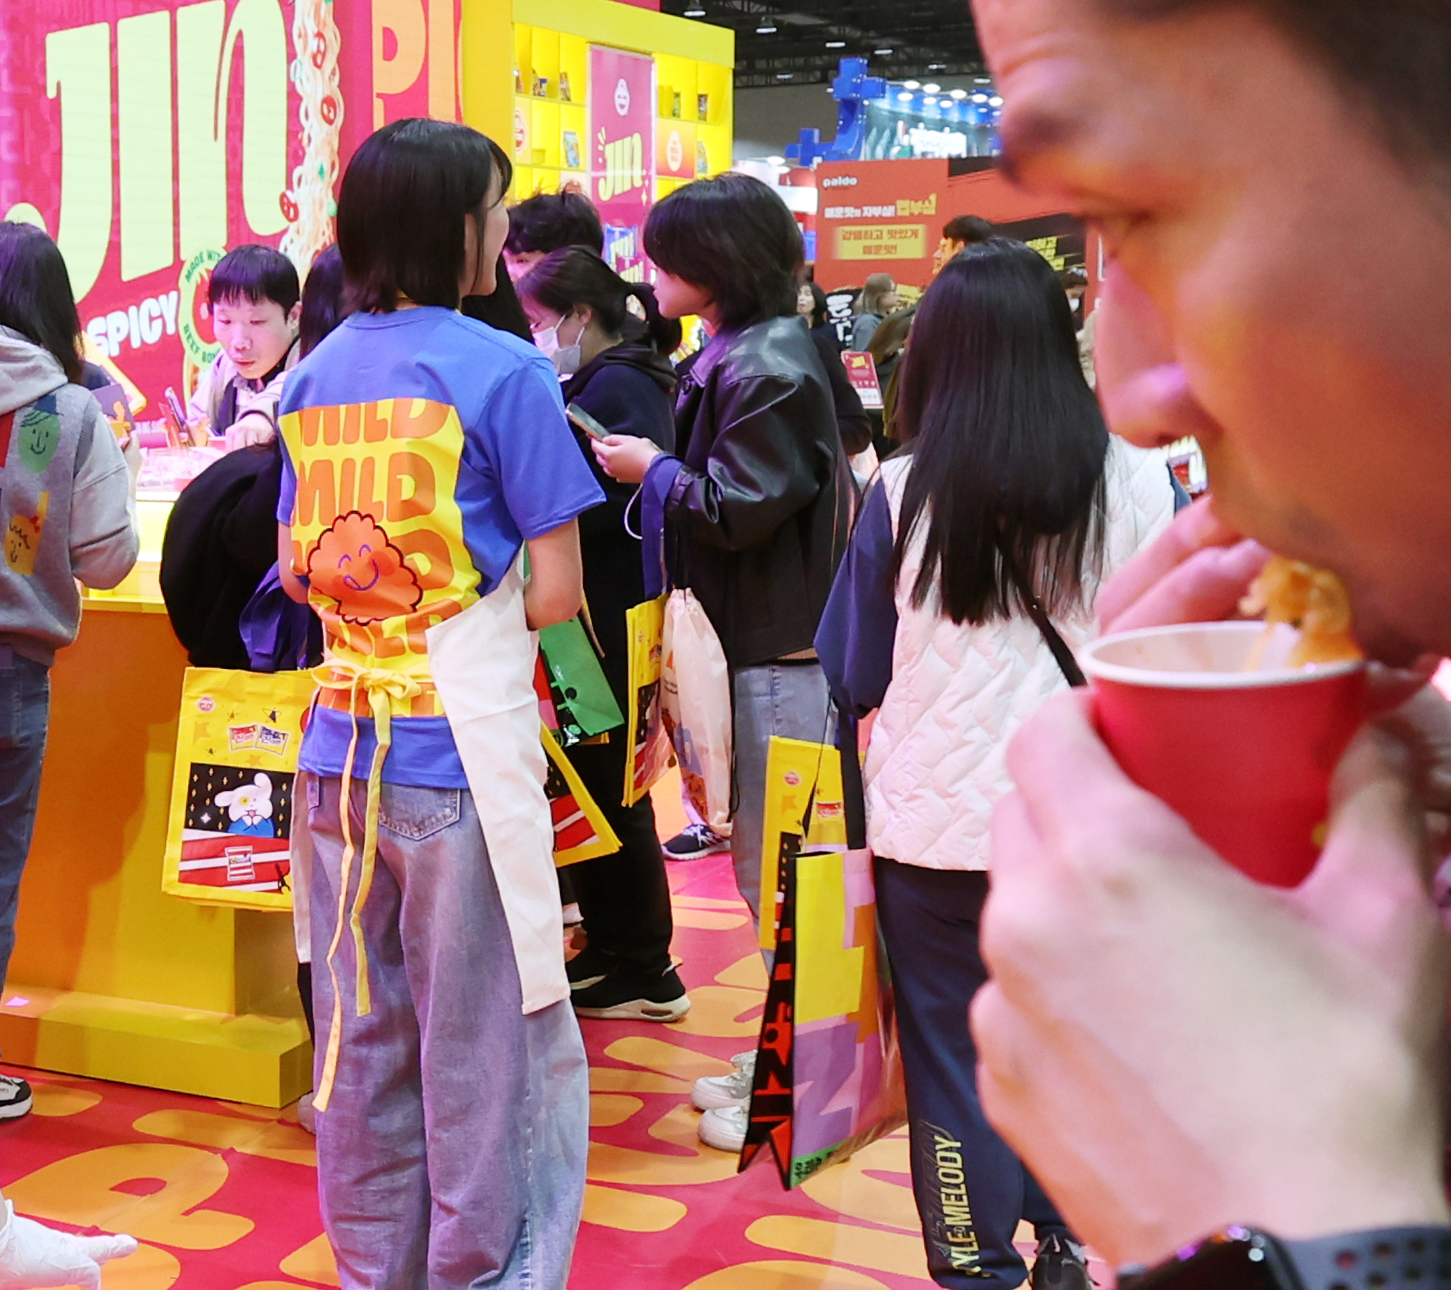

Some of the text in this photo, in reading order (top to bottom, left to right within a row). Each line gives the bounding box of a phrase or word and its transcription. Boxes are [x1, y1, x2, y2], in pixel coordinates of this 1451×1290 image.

[823, 176, 857, 188] paldo
[87, 291, 178, 357] SPICY
[934, 1135, 973, 1226] MELODY
